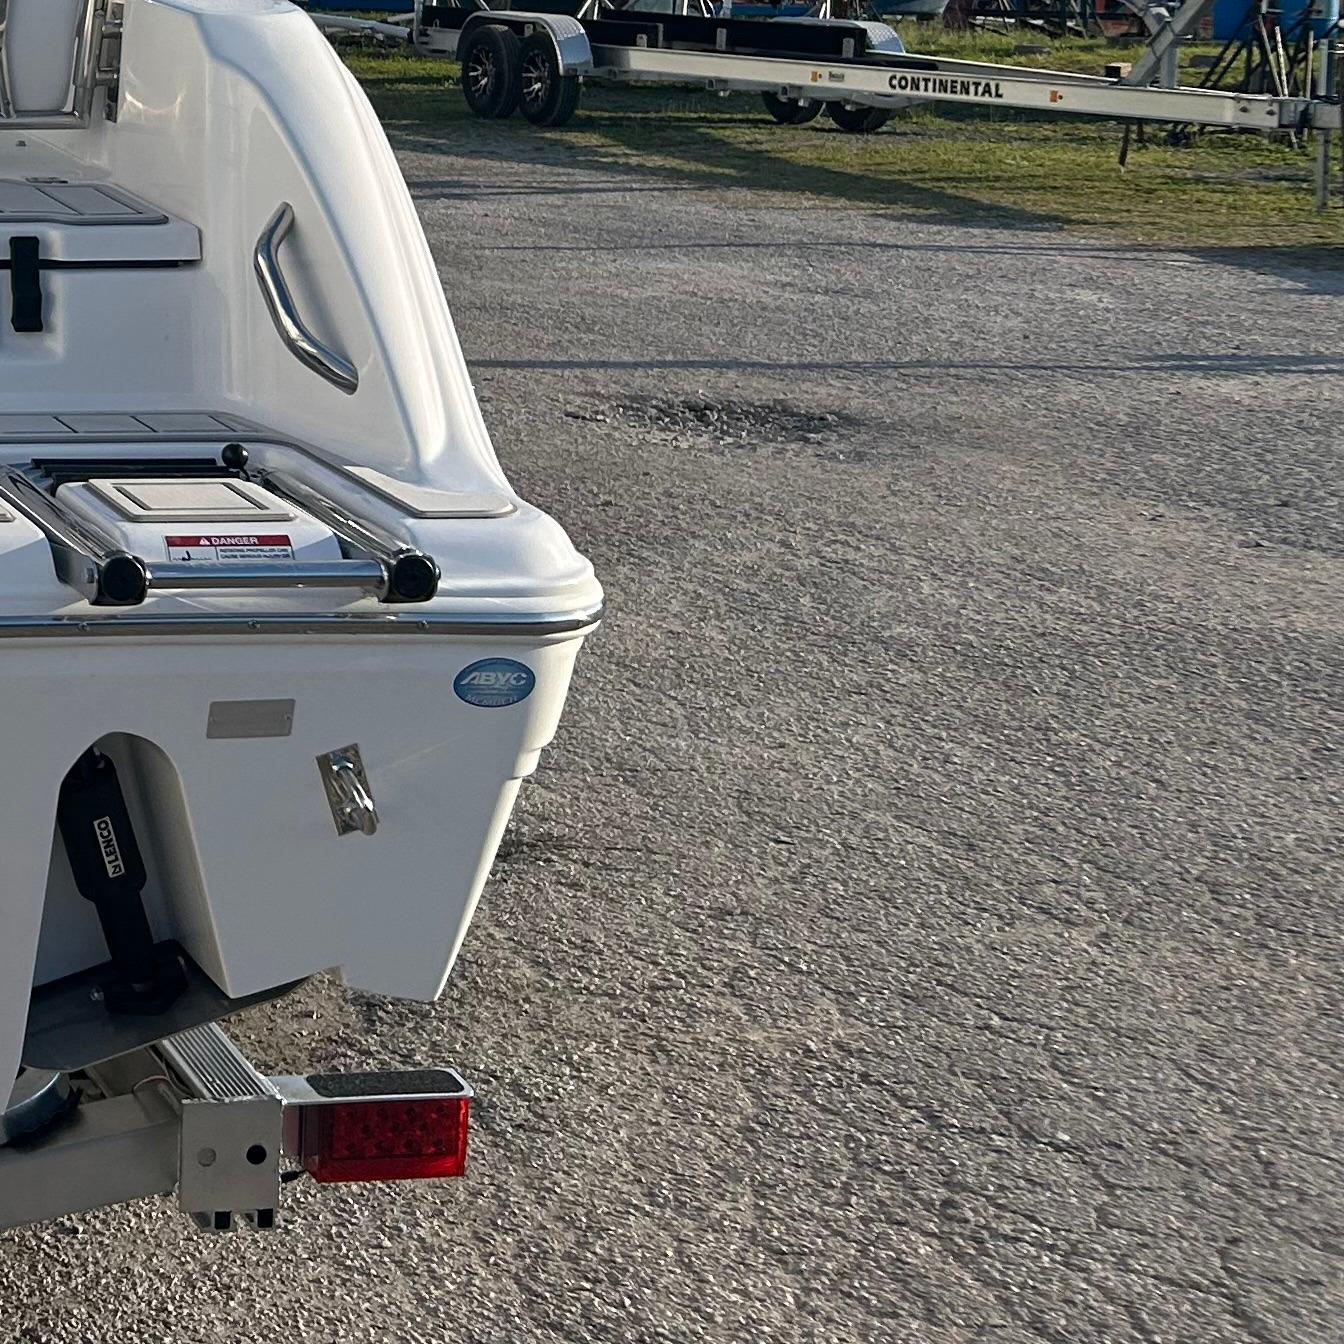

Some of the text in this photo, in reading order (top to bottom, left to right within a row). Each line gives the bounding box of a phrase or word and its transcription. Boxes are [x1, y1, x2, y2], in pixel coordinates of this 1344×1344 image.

[888, 74, 1003, 98] CONTINENTAL
[211, 536, 259, 545] DANGER
[459, 671, 528, 686] ABYC
[97, 819, 120, 865] LENCO
